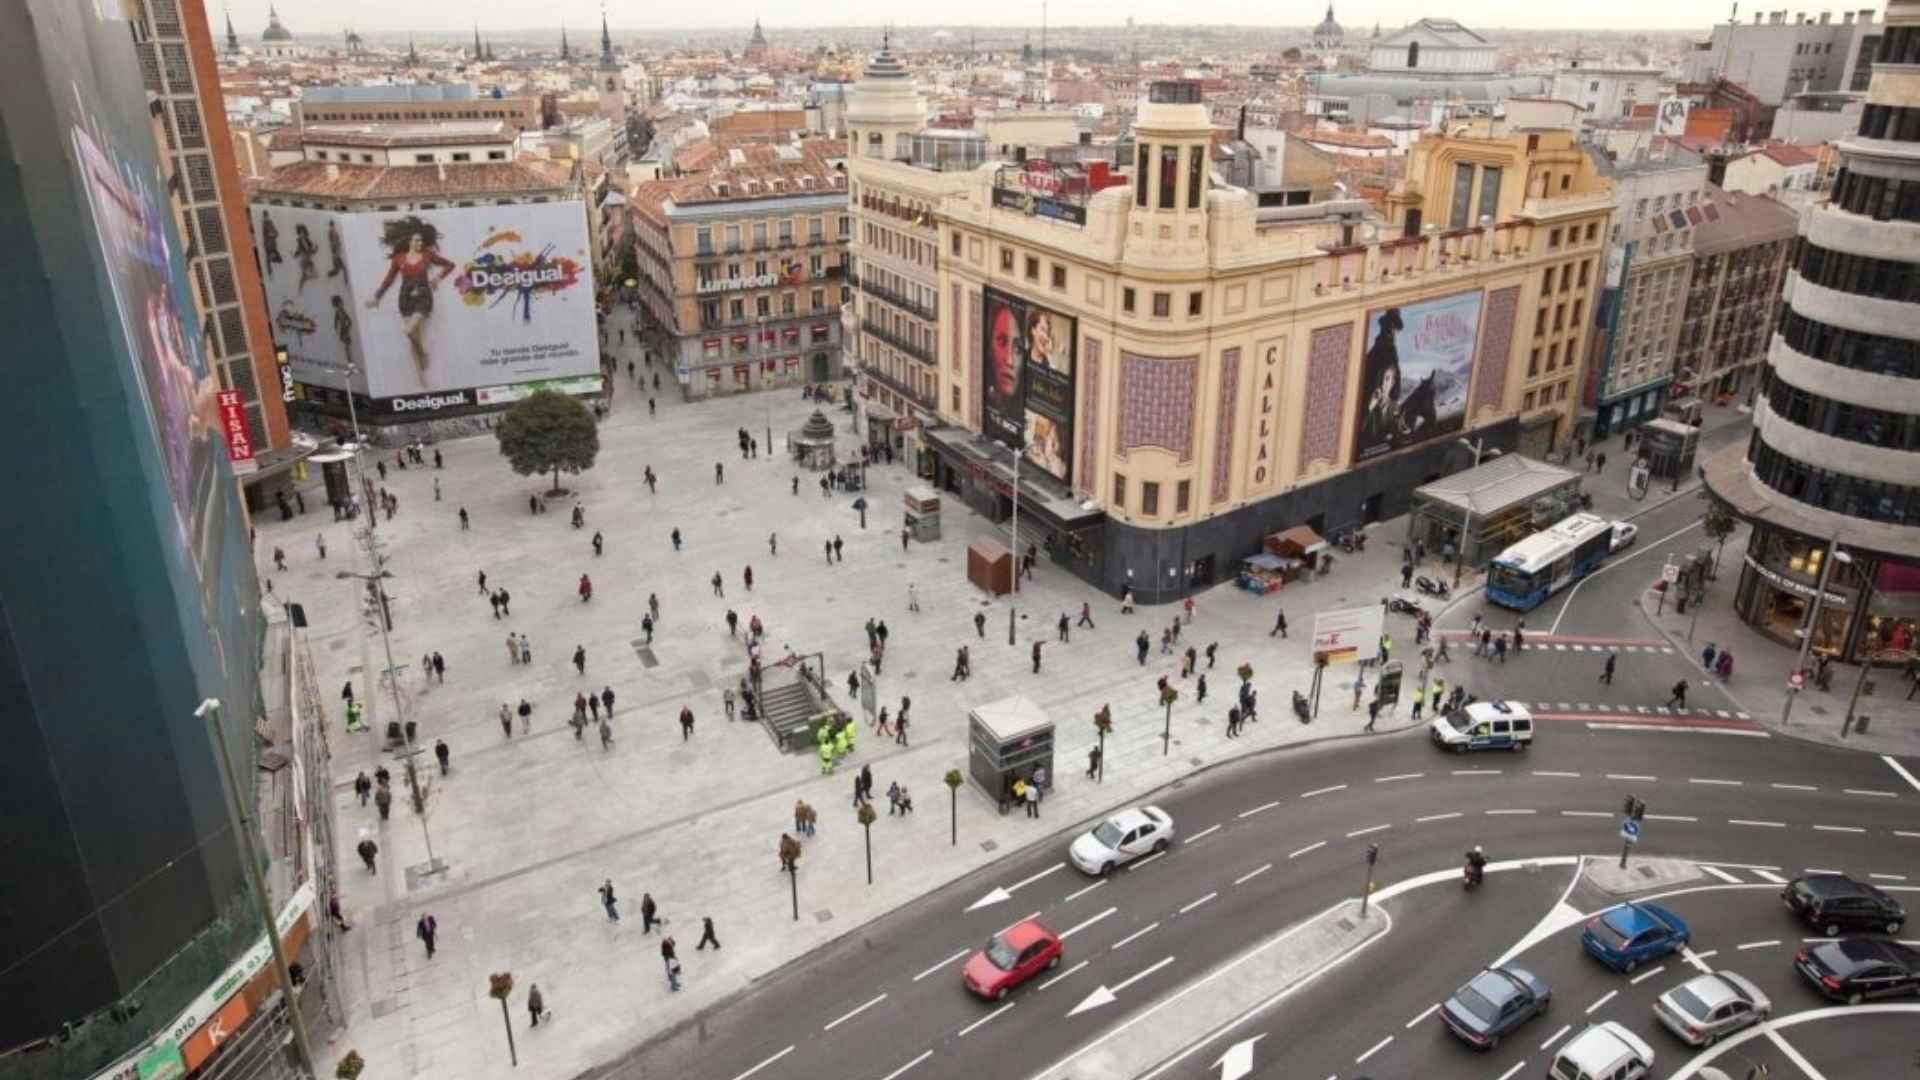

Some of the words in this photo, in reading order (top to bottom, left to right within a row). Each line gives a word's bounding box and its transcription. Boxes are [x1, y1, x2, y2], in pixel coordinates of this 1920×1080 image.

[281, 364, 296, 402] fnac
[221, 392, 250, 459] HISAN
[1255, 346, 1277, 483] CALLAO
[207, 1017, 227, 1046] K
